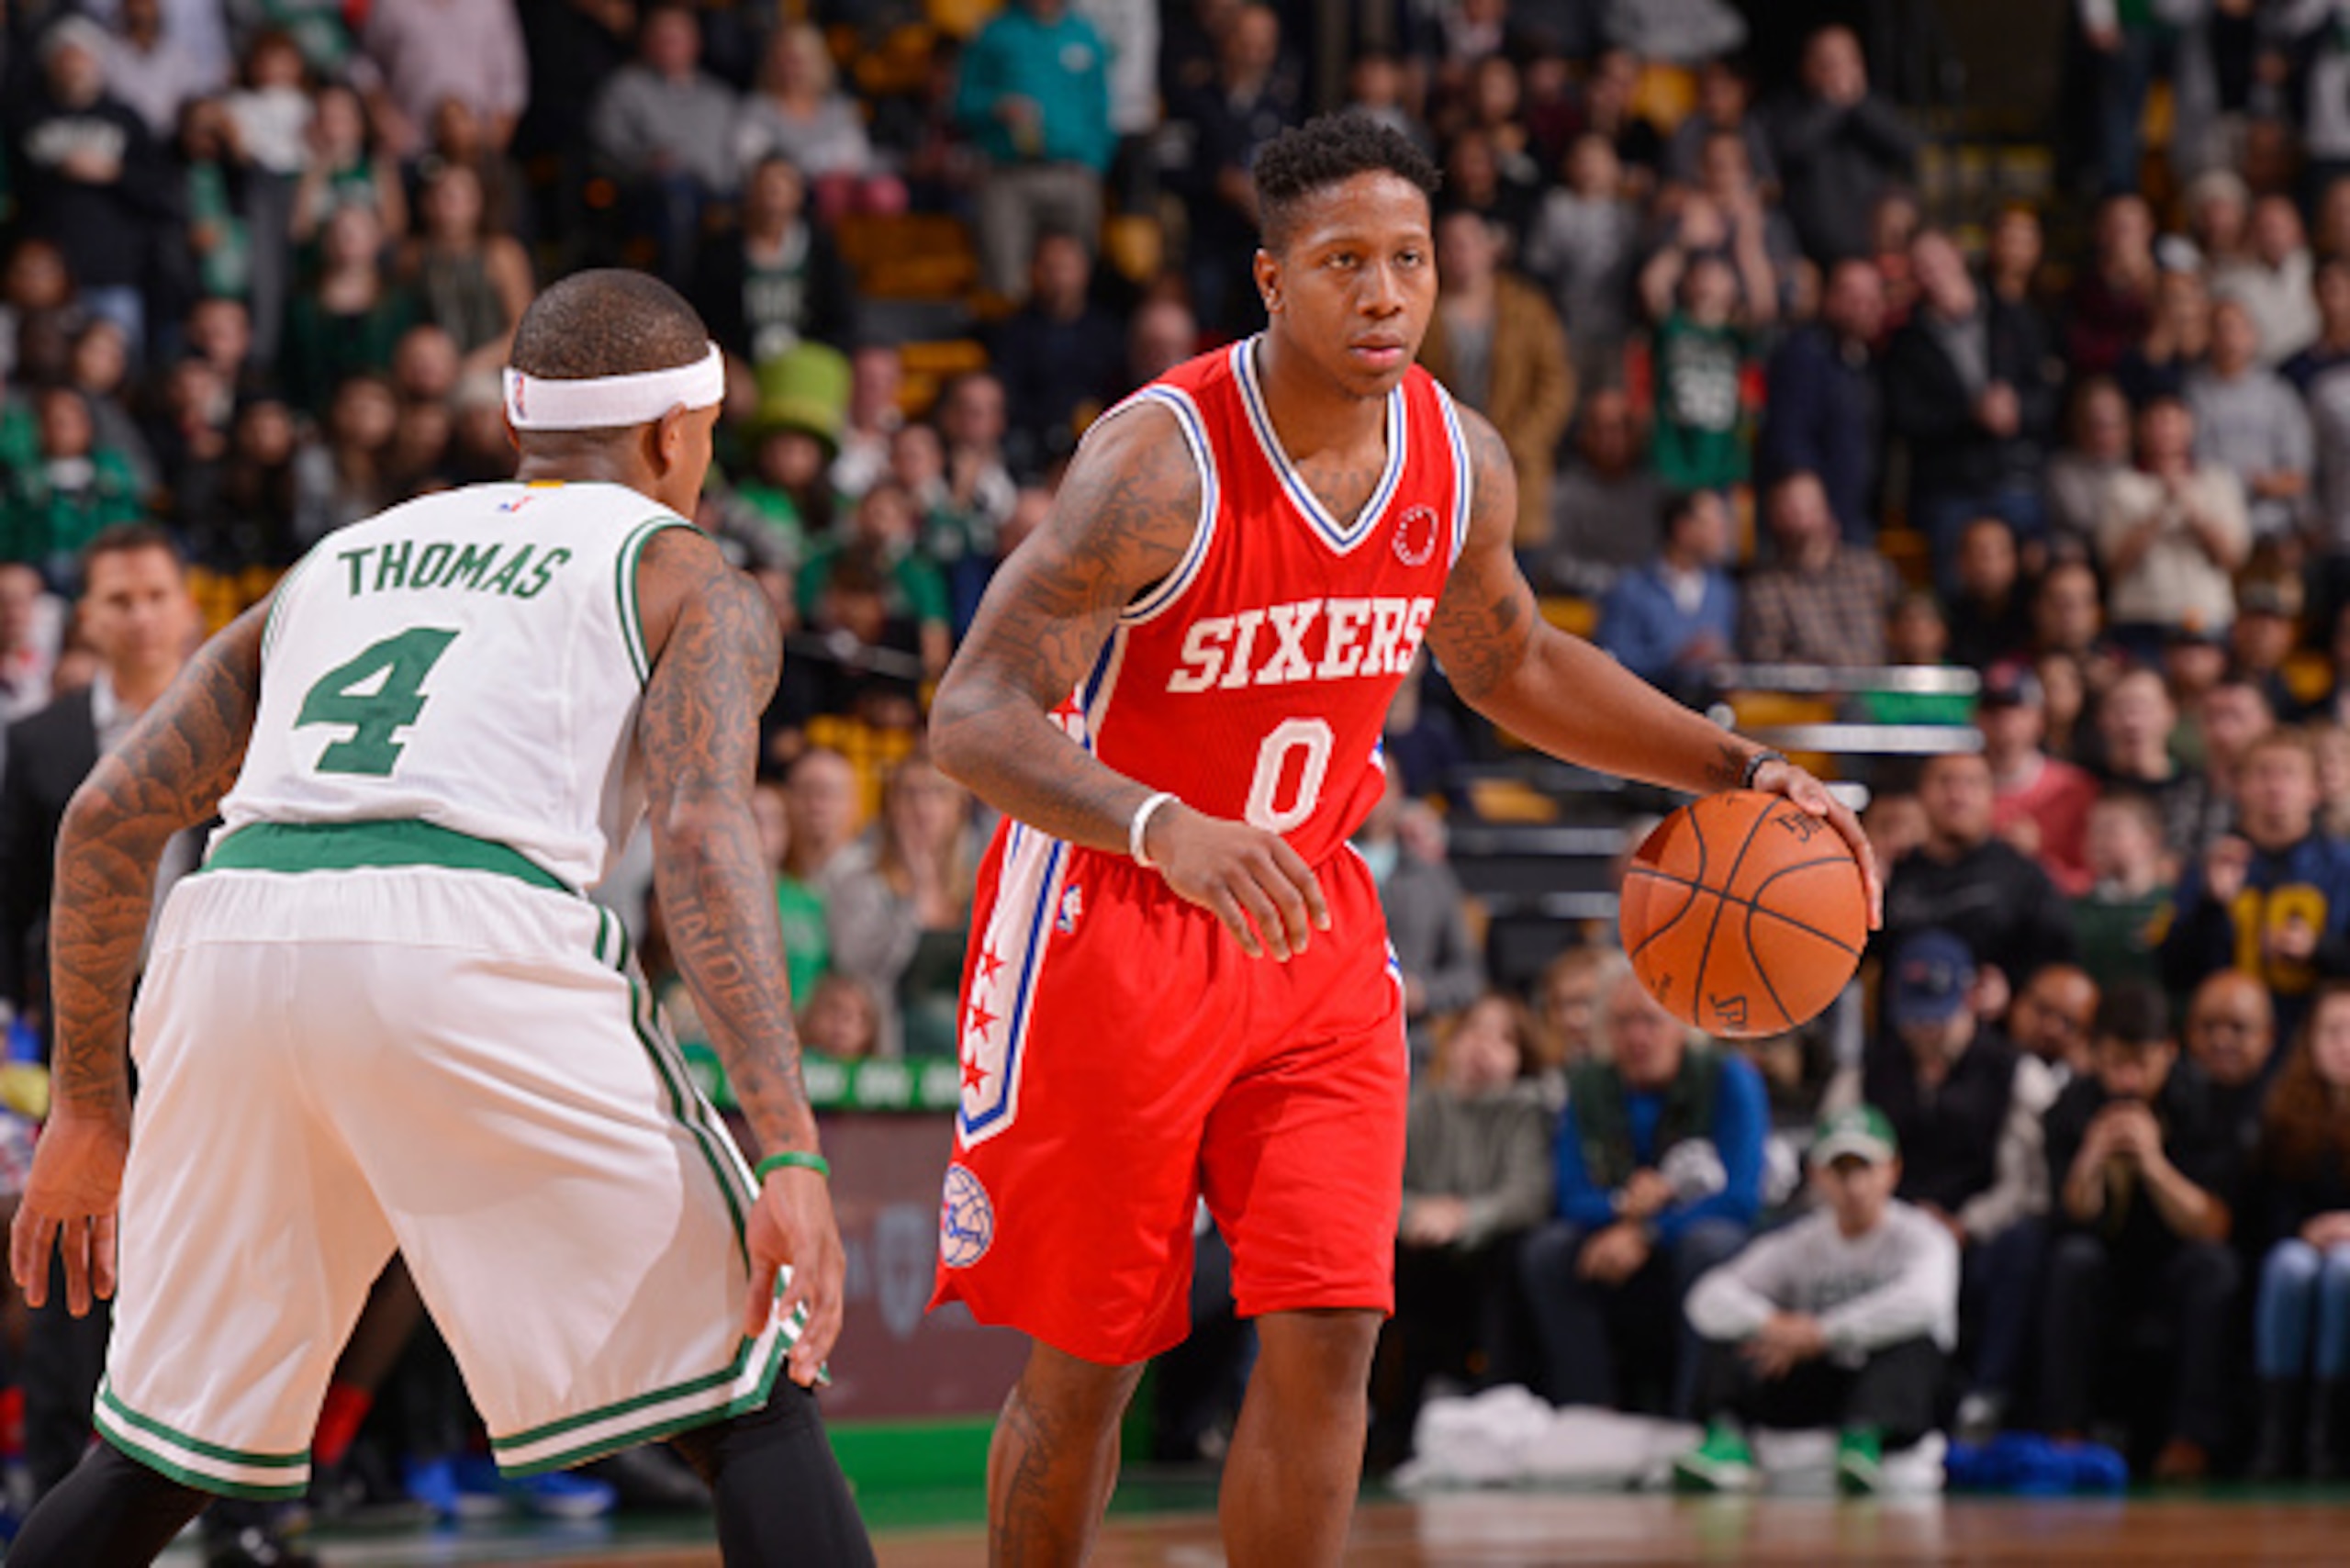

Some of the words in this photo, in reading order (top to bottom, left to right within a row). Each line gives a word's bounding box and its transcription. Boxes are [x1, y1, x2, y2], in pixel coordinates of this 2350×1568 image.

[339, 540, 571, 599] THOMAS
[1166, 597, 1436, 692] SIXERS
[294, 627, 460, 776] 4
[1244, 717, 1335, 834] 0
